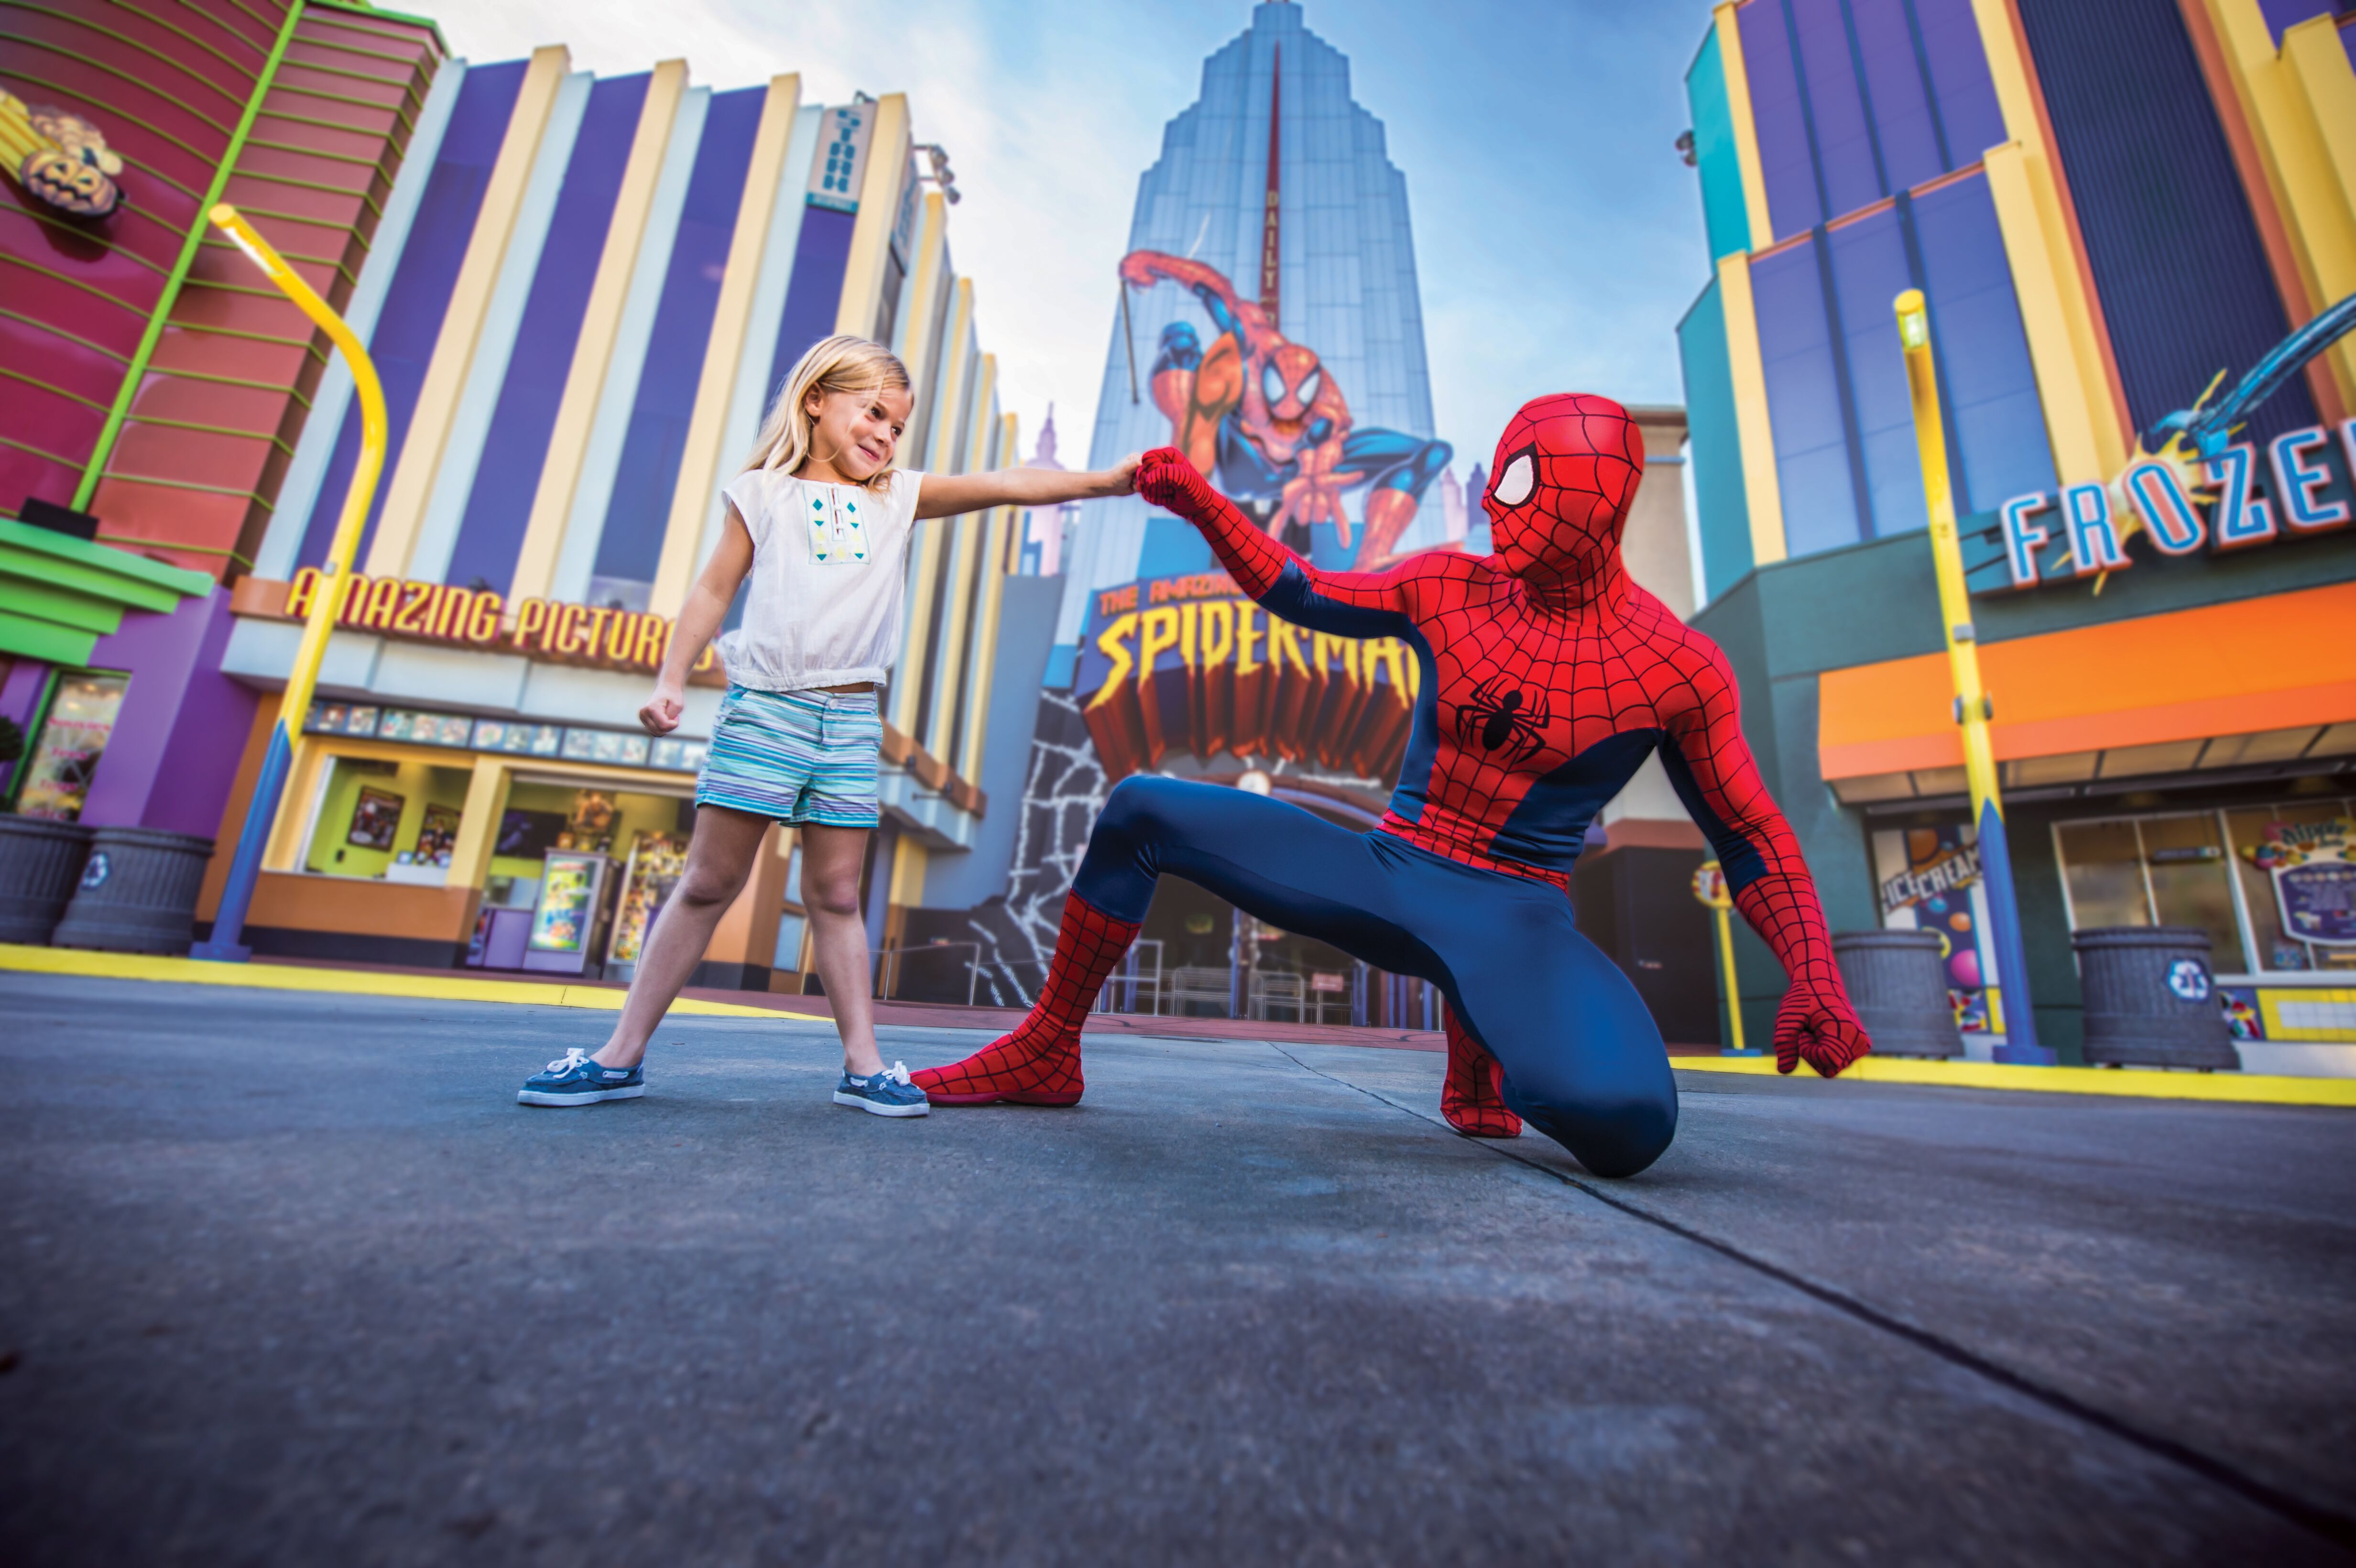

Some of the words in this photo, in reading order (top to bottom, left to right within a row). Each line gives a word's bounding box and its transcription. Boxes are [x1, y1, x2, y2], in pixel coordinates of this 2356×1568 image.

[1265, 192, 1279, 288] DAILY
[284, 566, 503, 642] AMAZING
[511, 597, 715, 673] PICTUR
[1099, 585, 1139, 617] THE
